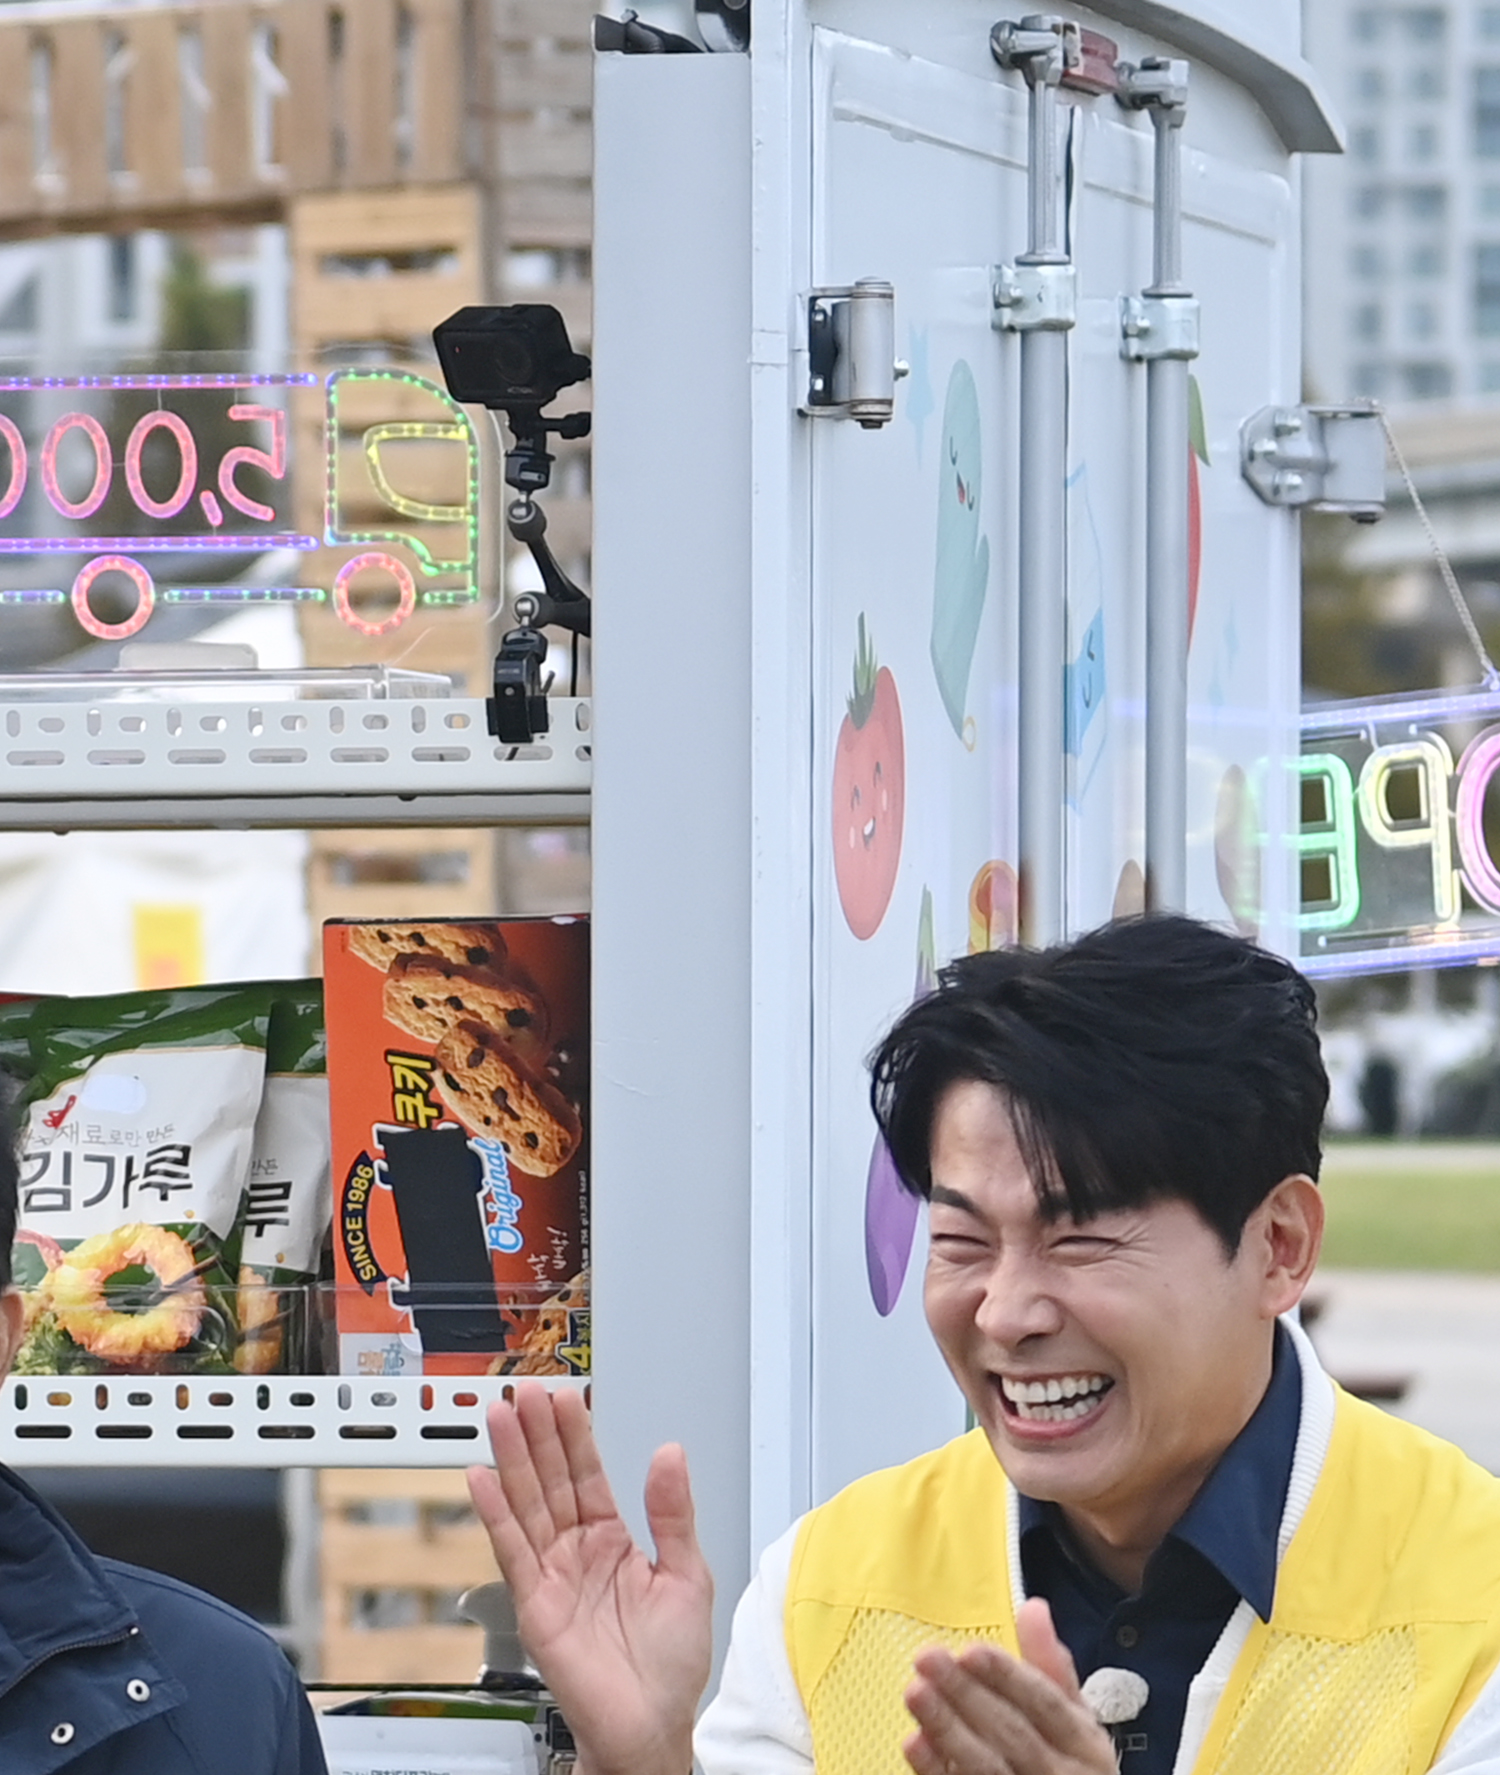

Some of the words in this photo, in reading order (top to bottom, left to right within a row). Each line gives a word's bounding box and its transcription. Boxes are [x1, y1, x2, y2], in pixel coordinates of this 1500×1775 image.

[387, 1054, 437, 1128] 쿠키
[19, 1142, 194, 1214] 김가루
[345, 1164, 374, 1214] 1986
[474, 1138, 522, 1252] Original
[345, 1217, 379, 1281] SINCE
